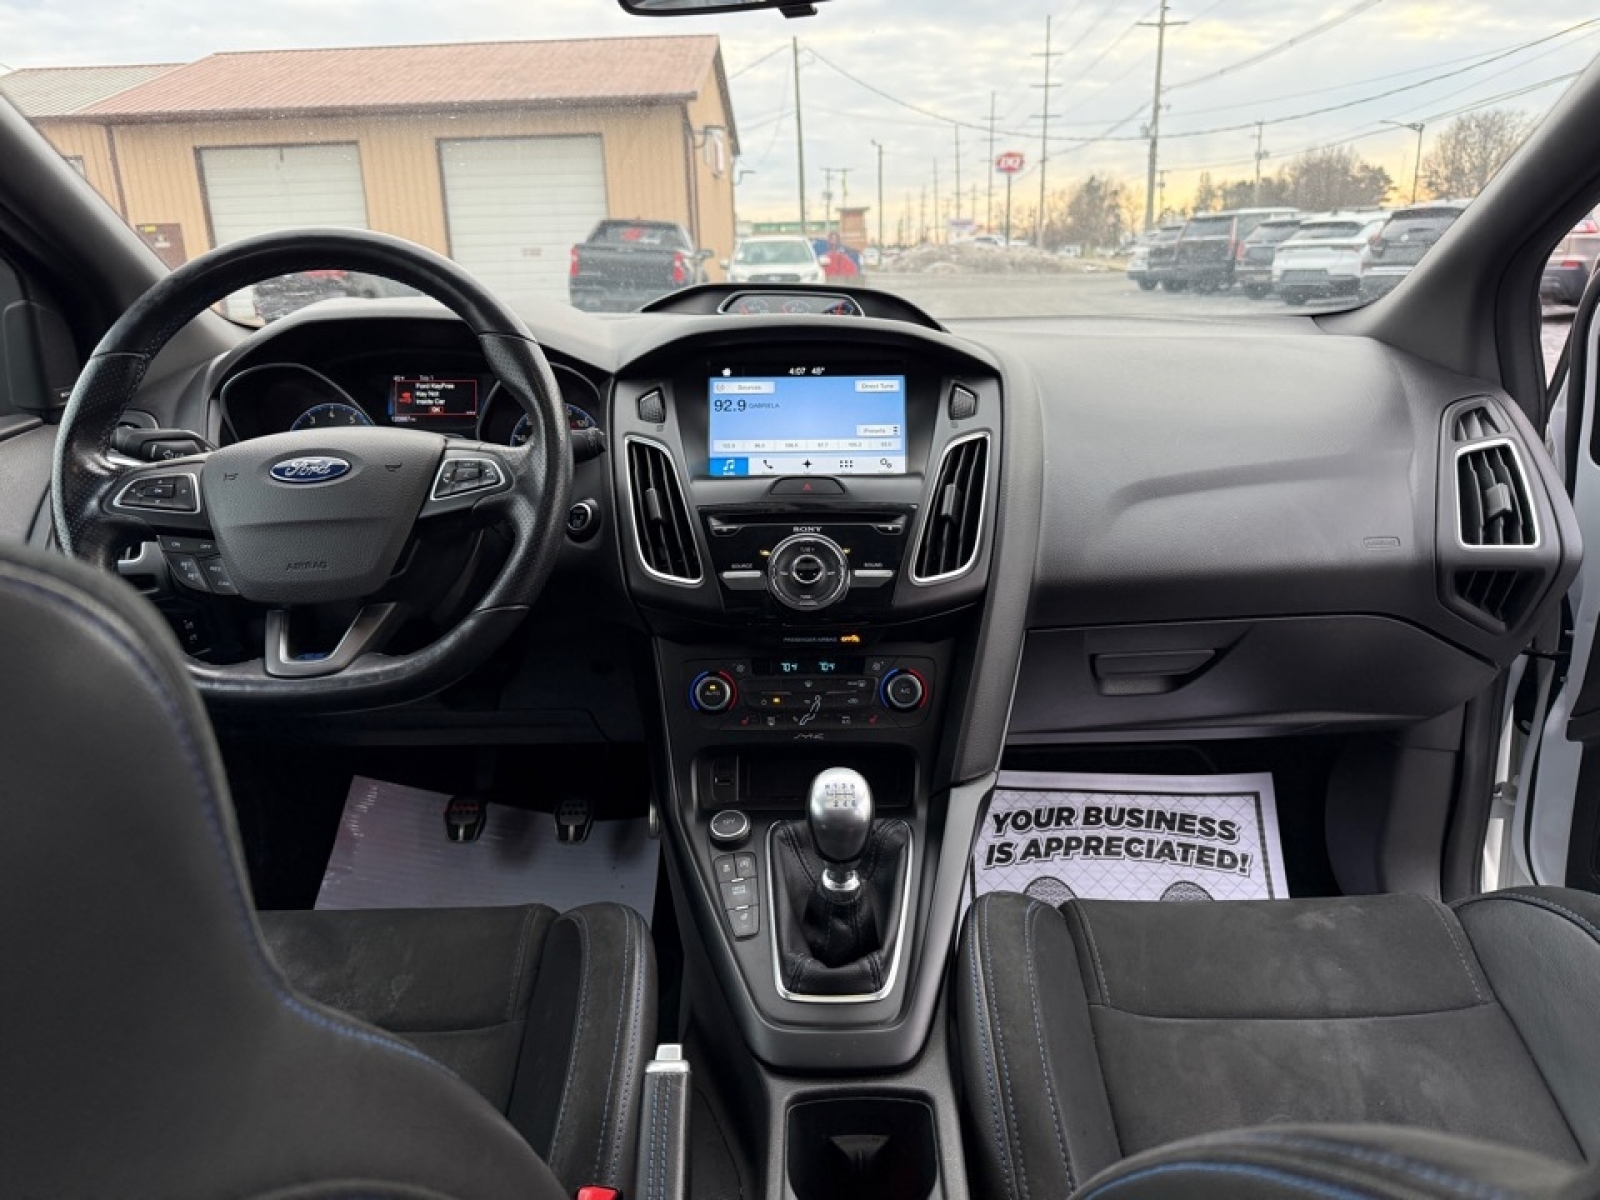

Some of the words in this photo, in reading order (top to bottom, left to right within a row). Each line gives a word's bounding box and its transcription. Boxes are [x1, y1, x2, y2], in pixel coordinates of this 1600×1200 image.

[714, 399, 747, 412] 92.9
[284, 460, 331, 476] Ford
[993, 806, 1076, 834] YOUR
[1082, 805, 1240, 842] BUSINESS
[984, 841, 1017, 869] IS
[1020, 835, 1252, 877] APPRECIATED!
